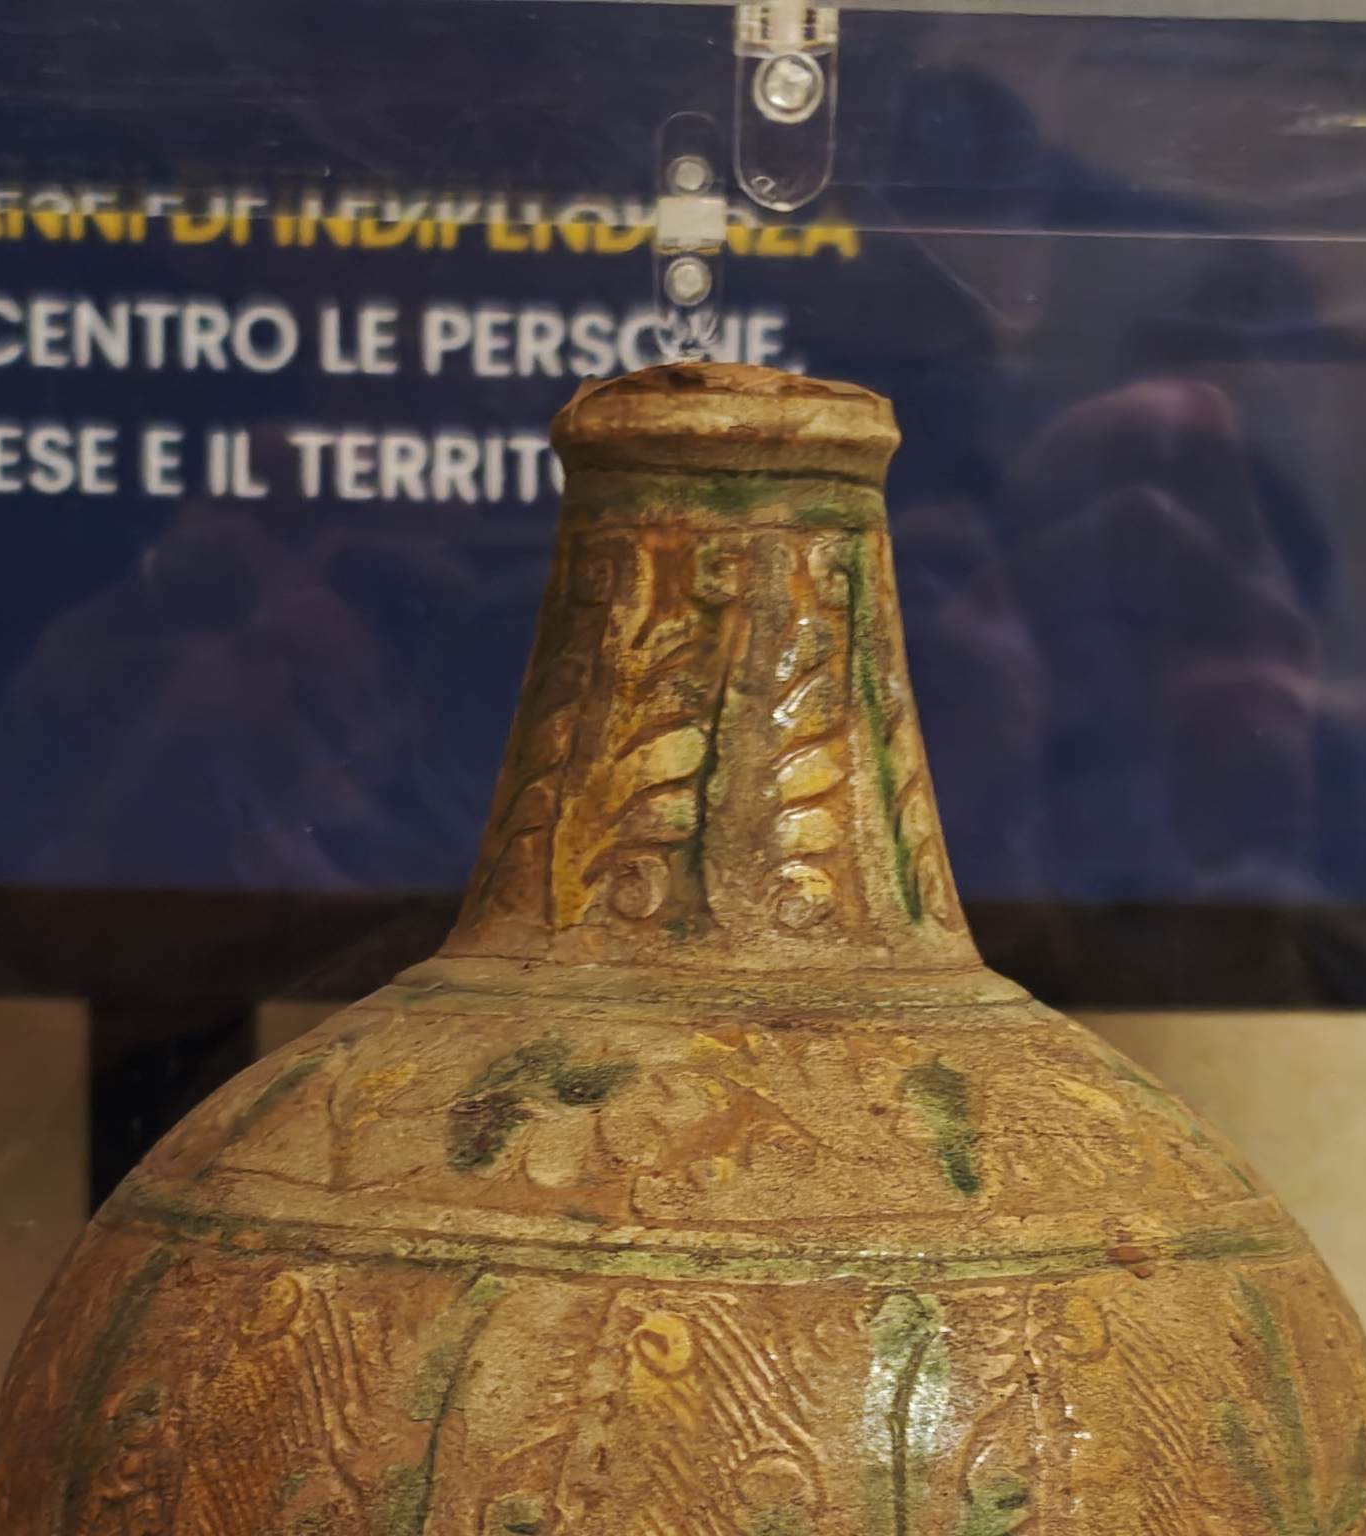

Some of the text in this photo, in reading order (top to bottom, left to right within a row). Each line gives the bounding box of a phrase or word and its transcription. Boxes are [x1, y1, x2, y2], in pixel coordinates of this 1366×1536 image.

[321, 306, 398, 375] LE
[144, 428, 182, 496] E
[208, 430, 267, 498] IL
